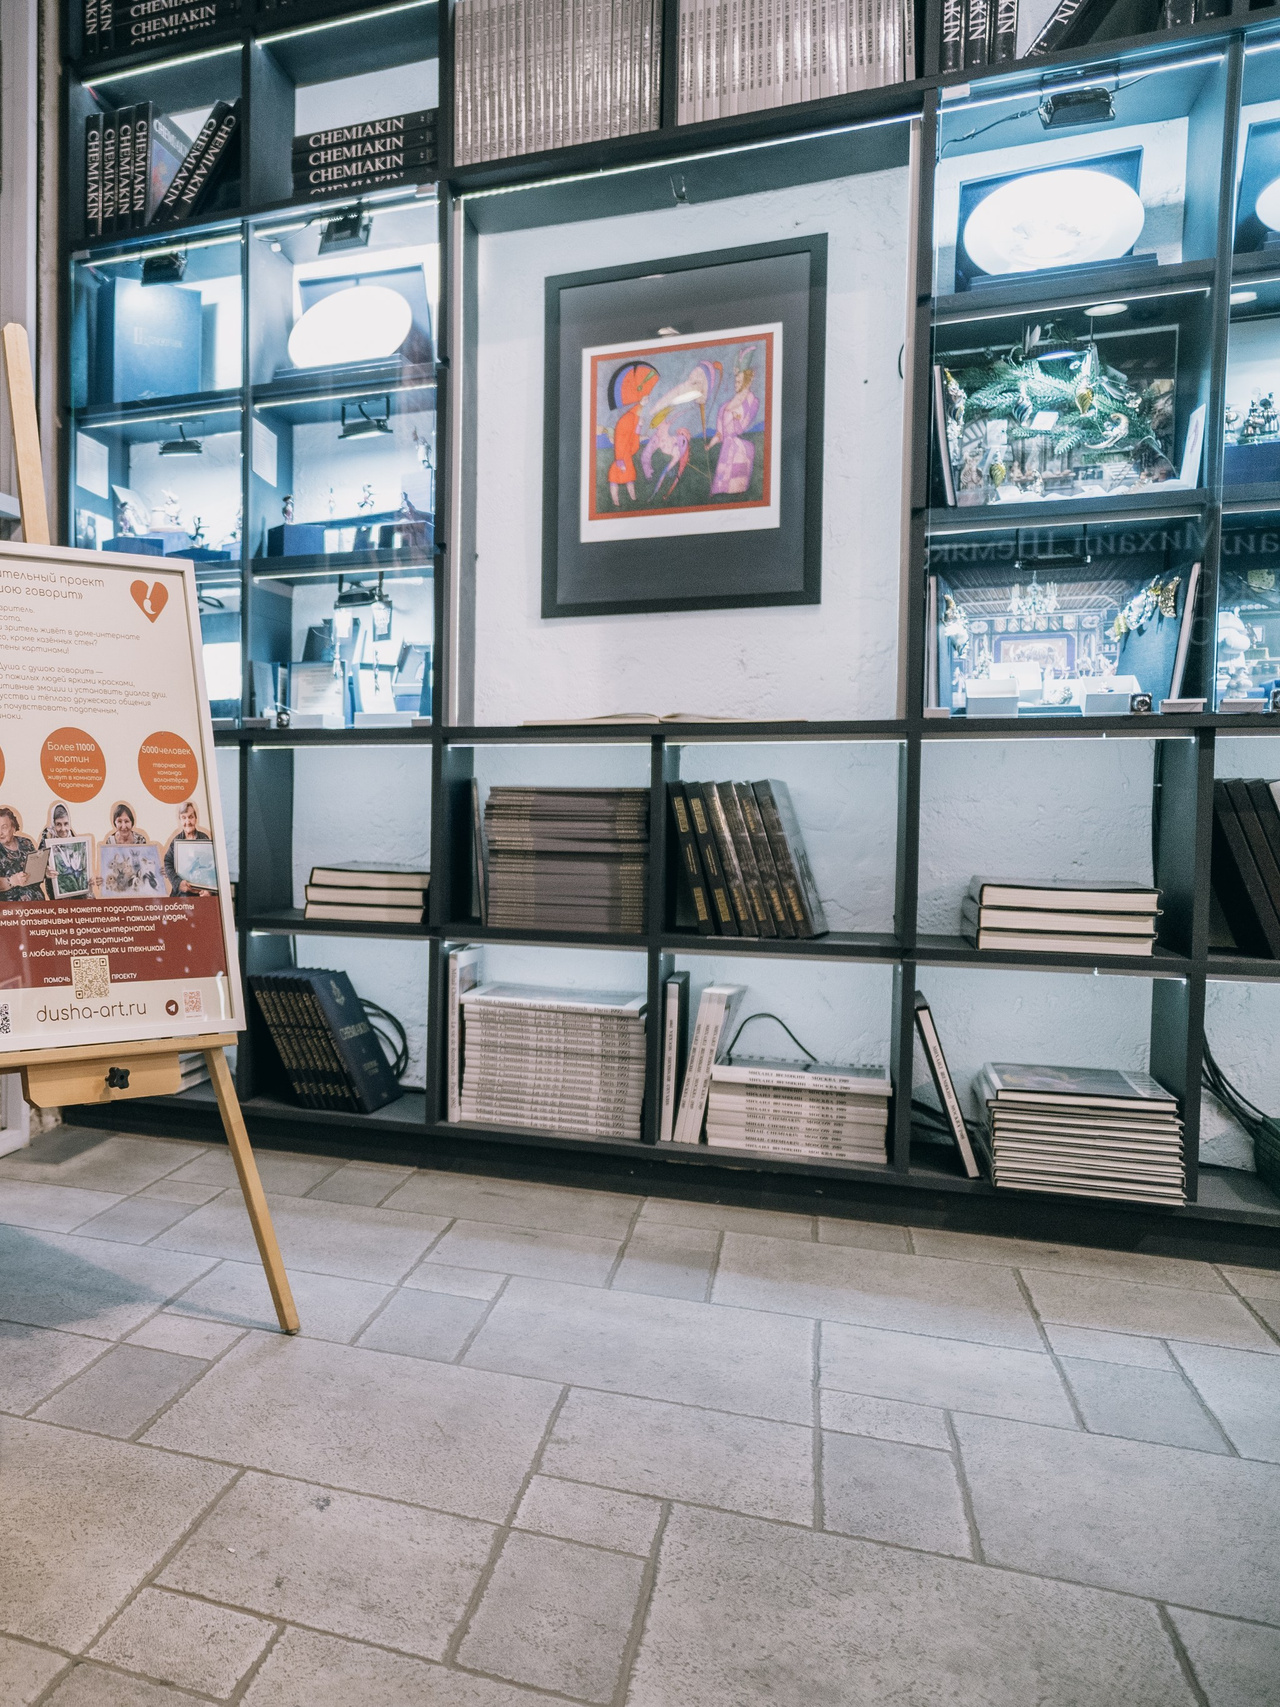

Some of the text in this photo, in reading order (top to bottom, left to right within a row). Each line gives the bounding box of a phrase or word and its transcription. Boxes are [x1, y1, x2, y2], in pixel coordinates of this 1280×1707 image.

[131, 4, 217, 36] CHEMIAKIN
[308, 117, 405, 148] CHEMIAKIN
[181, 115, 237, 203] CHEMIAKIN
[308, 135, 404, 166] CHEMIAKIN
[118, 125, 131, 215] CHEMIAKIN
[133, 120, 147, 211] CHEMIAKIN
[163, 118, 217, 206] CHEMIAKIN
[308, 153, 404, 184] CHEMIAKIN
[87, 130, 100, 219] CHEMIAKIN
[104, 129, 116, 218] CHEMIAKIN
[59, 575, 104, 587] проект
[24, 586, 83, 600] говорит»
[4, 624, 39, 633] зритель
[39, 627, 66, 635] живёт
[73, 629, 140, 641] доме-интернате
[46, 740, 95, 752] Более 11000
[141, 745, 191, 755] 5000 человек
[53, 754, 90, 764] картин
[1, 908, 14, 916] вы
[14, 907, 57, 917] художник,
[57, 906, 69, 914] вы
[69, 905, 102, 913] можете
[102, 904, 144, 914] подарить
[163, 901, 194, 912] работы
[19, 917, 74, 926] отзывчивым
[73, 915, 120, 925] ценителям
[125, 914, 161, 922] пожилым
[161, 913, 188, 923] людям,
[28, 922, 155, 938] живущим в домах-интернатах!
[27, 948, 55, 957] любых
[56, 947, 88, 956] жанрах,
[90, 946, 119, 954] стилях
[127, 942, 165, 952] техниках!
[54, 935, 134, 947] Мы рады картинам
[42, 975, 69, 983] ПОМОЧЬ
[35, 1000, 146, 1022] dusha-art.ru
